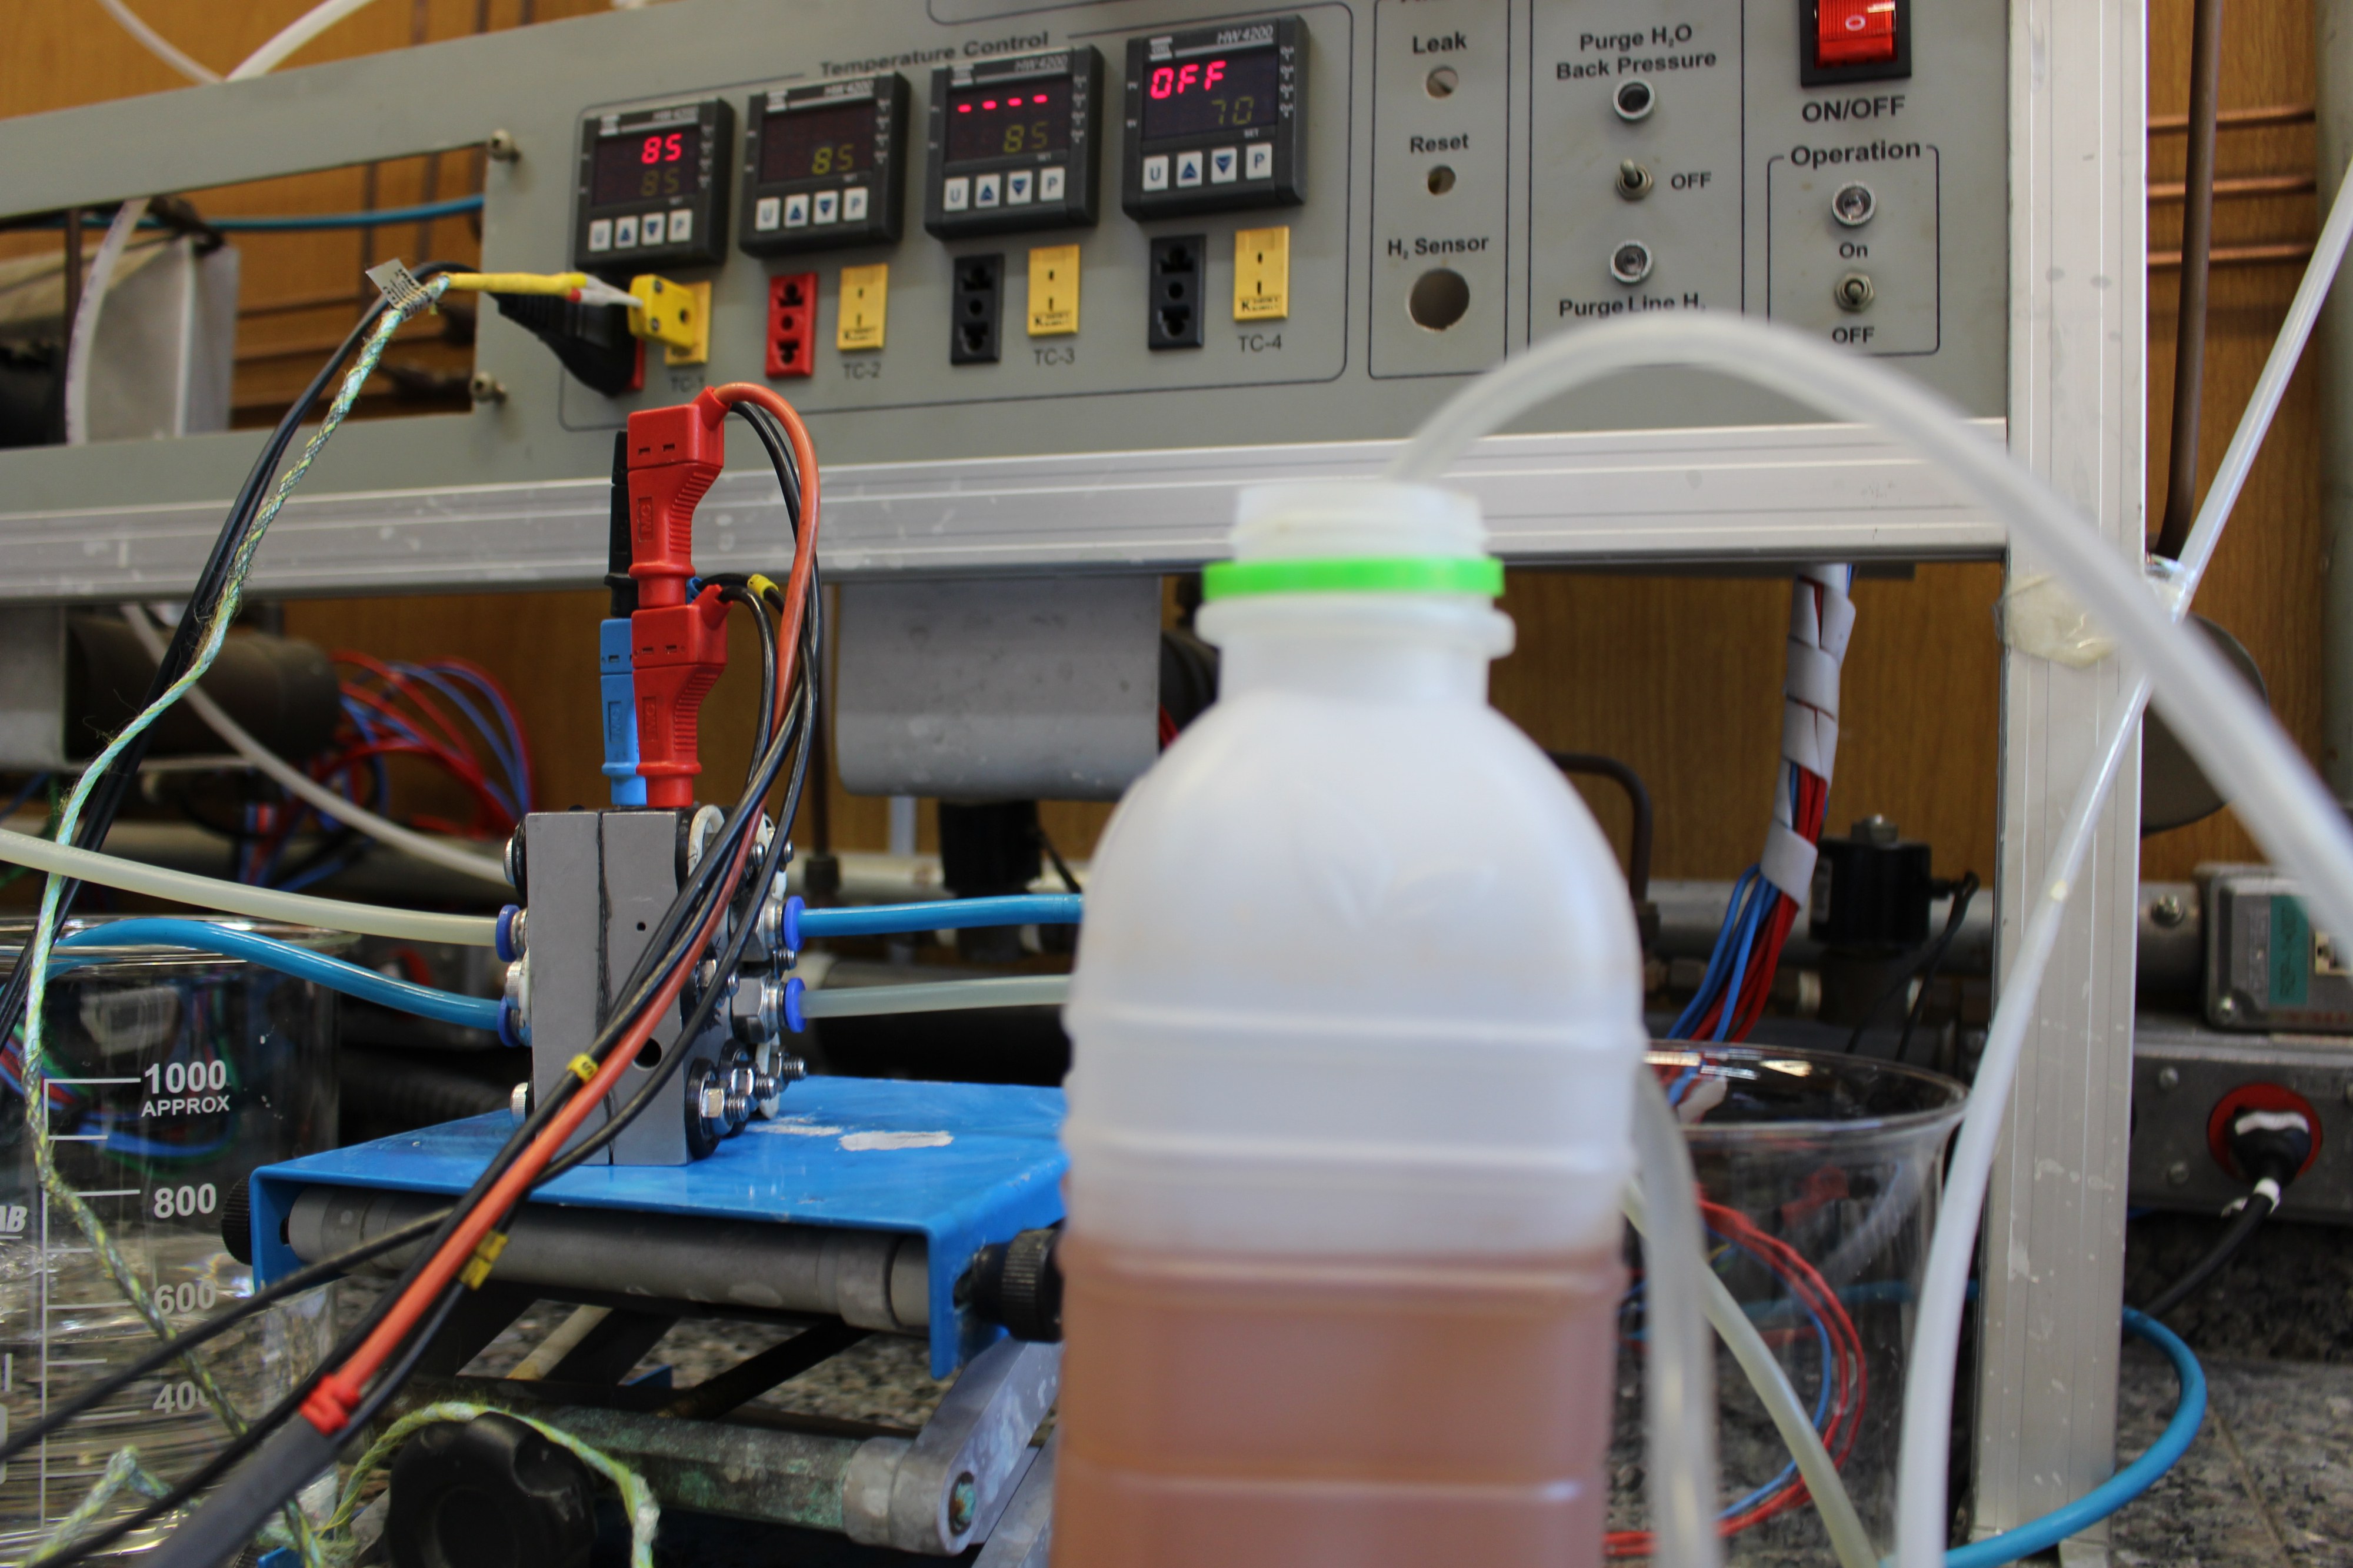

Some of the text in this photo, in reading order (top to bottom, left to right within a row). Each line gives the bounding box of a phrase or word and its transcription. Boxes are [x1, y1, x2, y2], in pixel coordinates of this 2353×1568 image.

[1413, 32, 1467, 55] Leak
[1579, 32, 1644, 52] Purge
[821, 31, 1049, 76] Temperature Control
[1556, 52, 1717, 81] Back Pressure
[1150, 60, 1227, 99] OFF
[1211, 96, 1255, 125] 70
[1802, 95, 1906, 123] ON/OFF
[1002, 121, 1048, 153] 85
[1411, 134, 1469, 154] Reset
[641, 133, 683, 164] 85
[811, 144, 855, 175] 85
[1791, 139, 1921, 169] Operation
[1255, 152, 1265, 169] P
[1047, 176, 1057, 192] P
[1150, 166, 1161, 181] U
[1671, 172, 1712, 191] OFF
[950, 188, 961, 203] U
[1415, 236, 1489, 256] Sensor
[1839, 242, 1868, 258] On
[1559, 298, 1624, 318] Purge
[1628, 295, 1675, 312] Line
[1237, 333, 1281, 353] TC-4
[1832, 326, 1875, 343] OFF
[1033, 346, 1075, 366] TC-3
[841, 361, 882, 380] TC-2
[144, 1060, 227, 1094] 1000
[141, 1095, 230, 1117] APPROX
[154, 1183, 216, 1219] 800
[154, 1281, 216, 1315] 600
